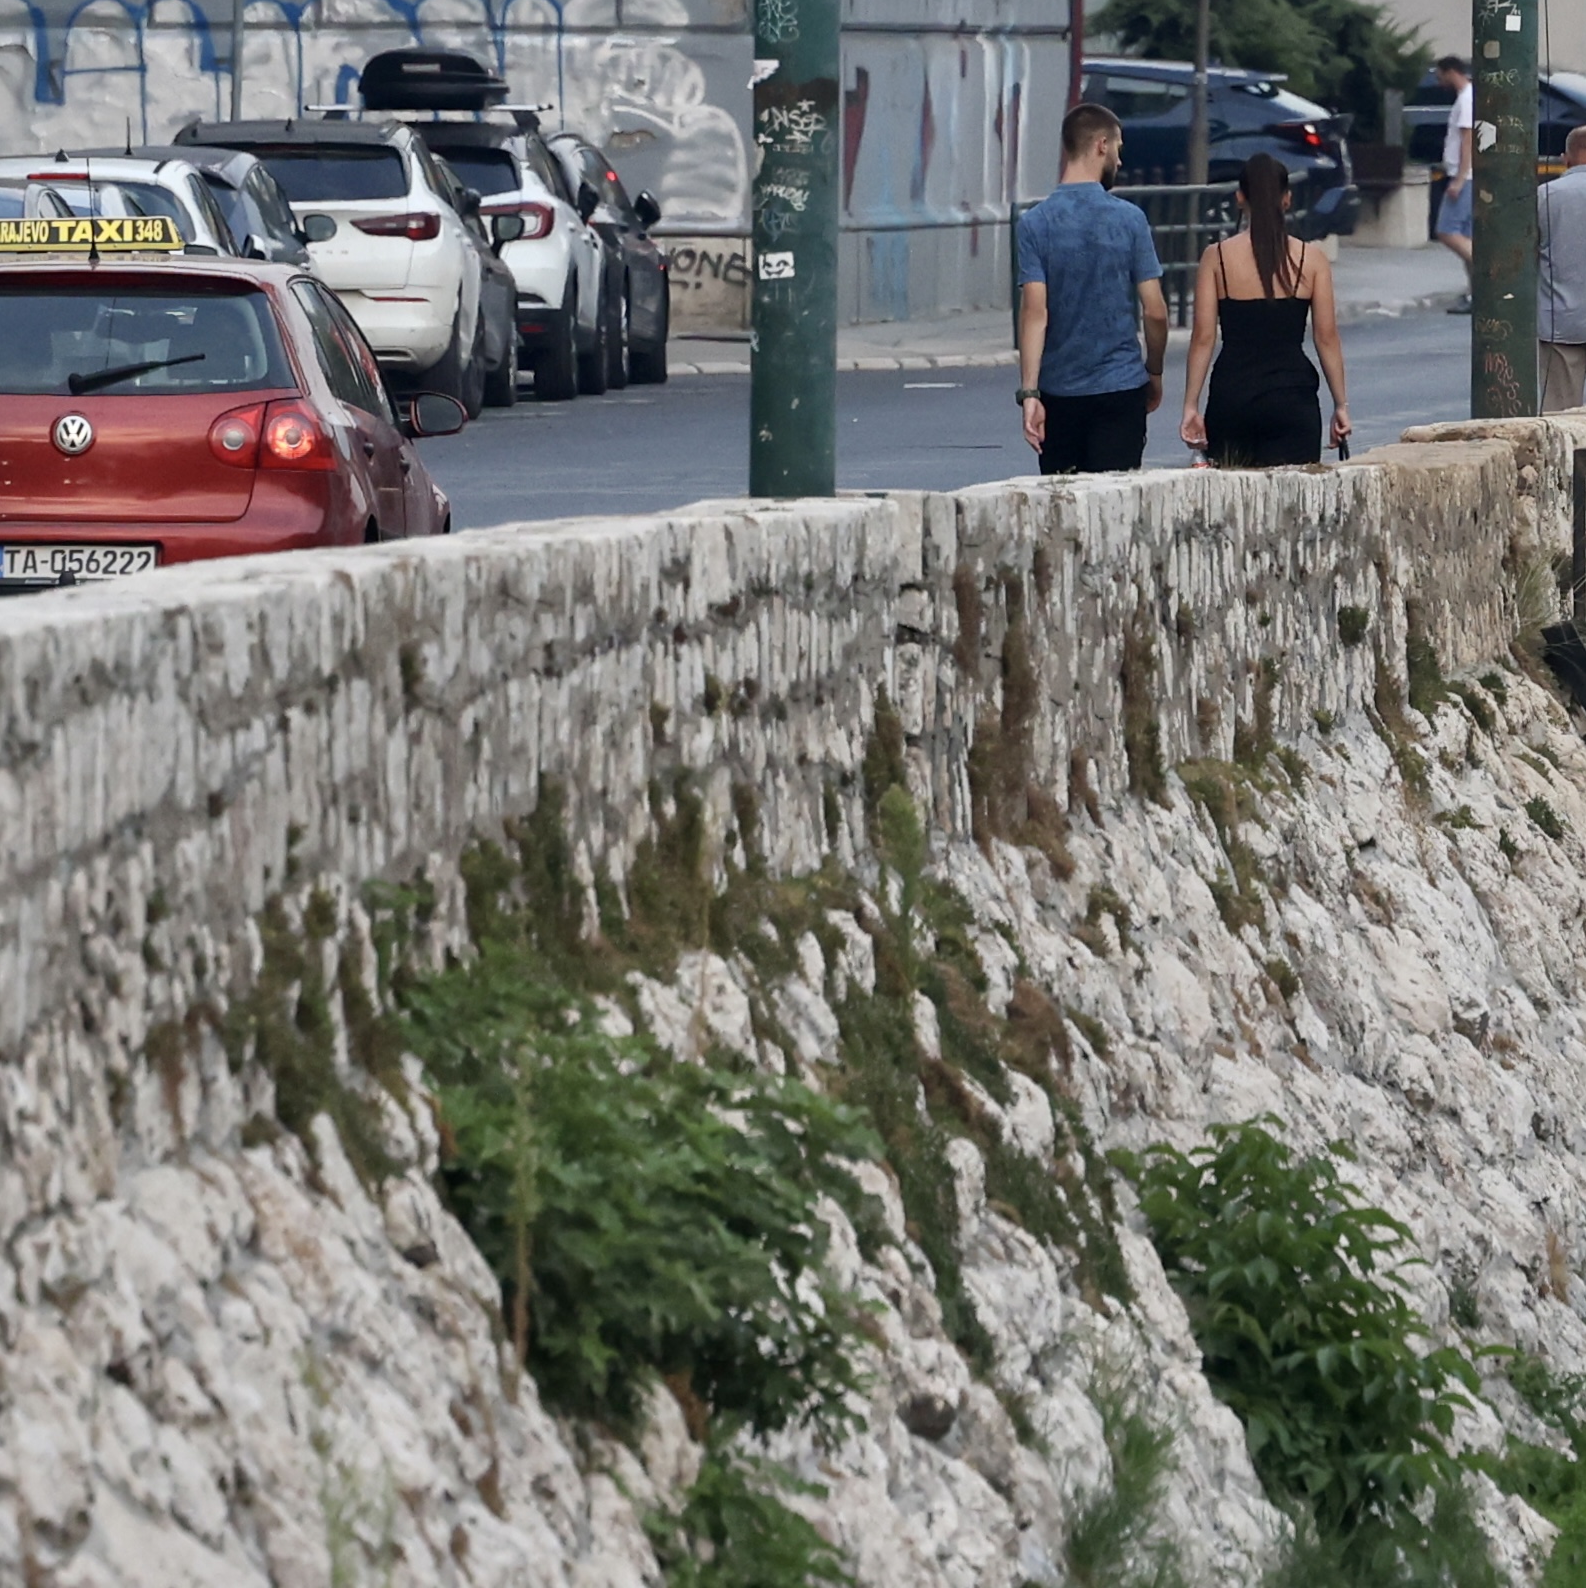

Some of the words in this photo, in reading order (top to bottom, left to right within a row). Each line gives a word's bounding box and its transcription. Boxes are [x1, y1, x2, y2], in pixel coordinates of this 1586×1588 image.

[51, 220, 132, 243] TAXI
[135, 220, 163, 242] 348
[4, 549, 152, 575] TA-056222
